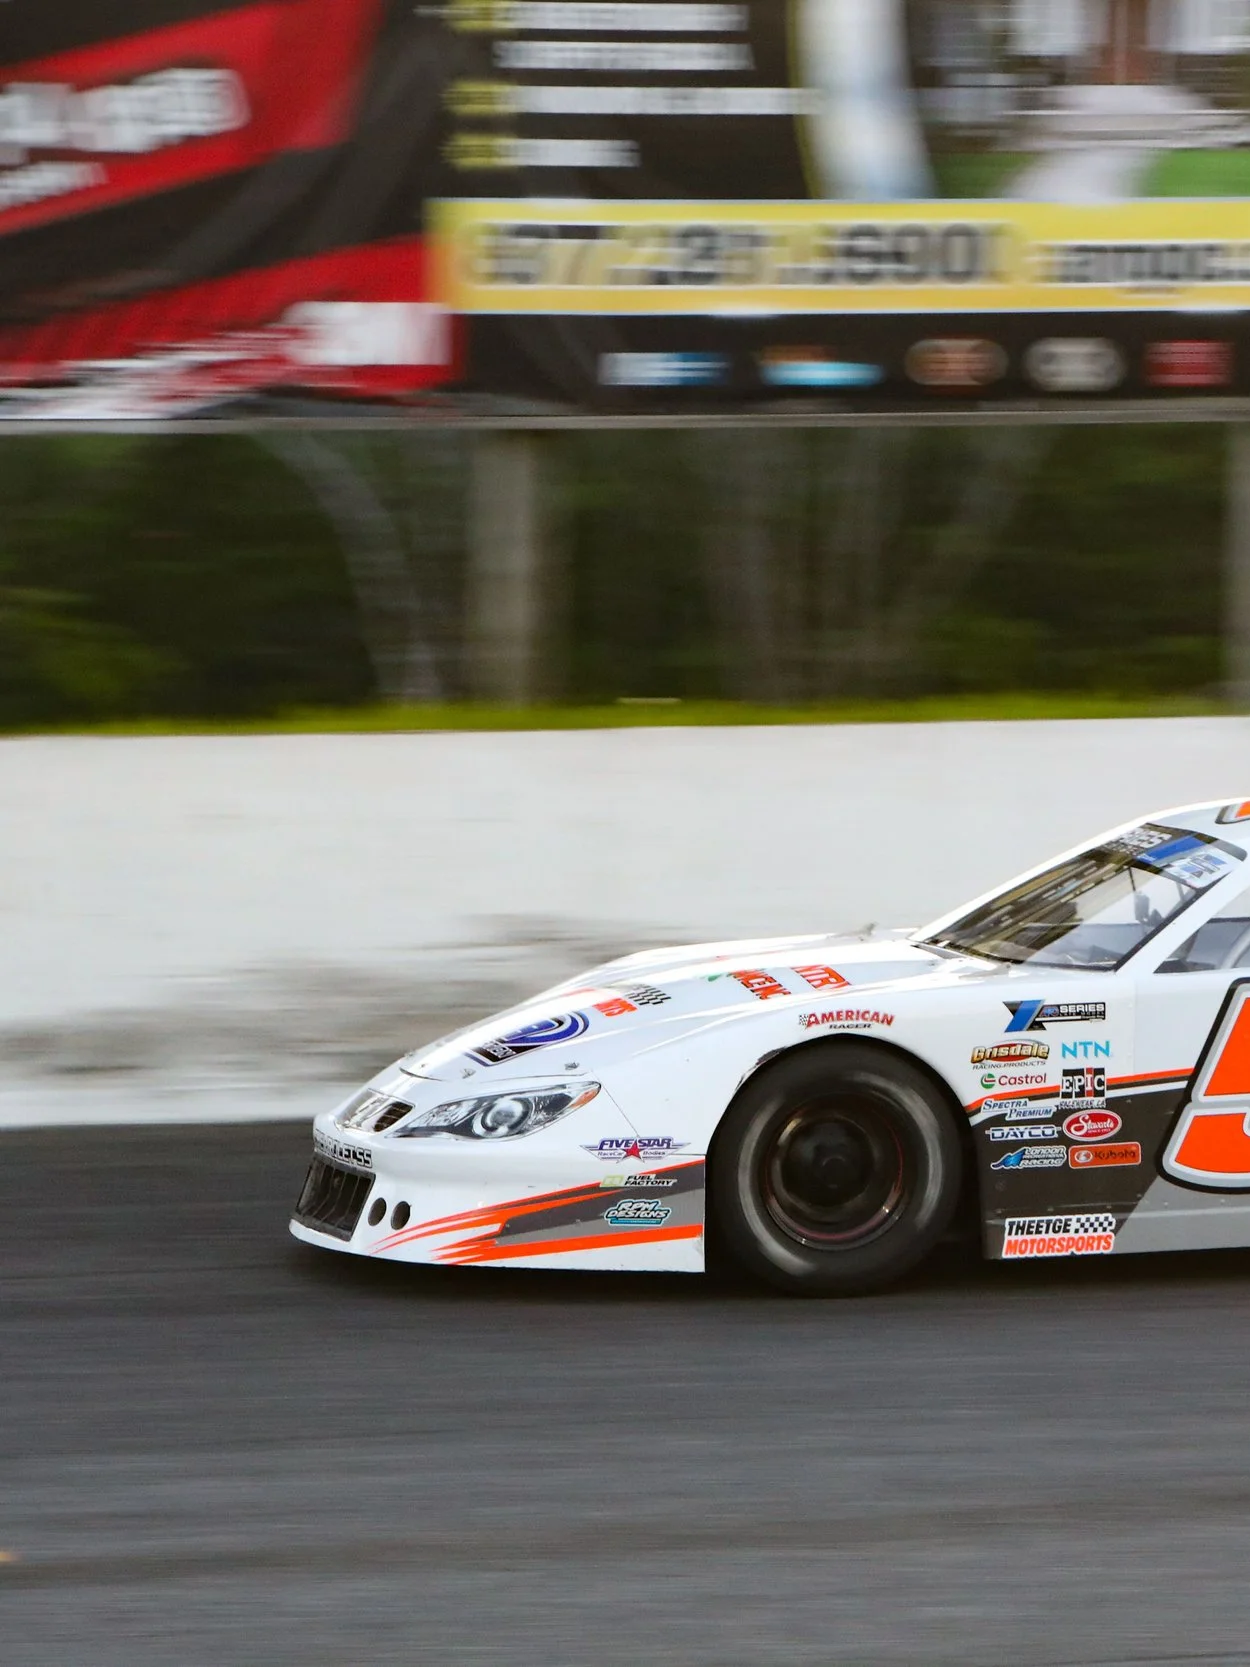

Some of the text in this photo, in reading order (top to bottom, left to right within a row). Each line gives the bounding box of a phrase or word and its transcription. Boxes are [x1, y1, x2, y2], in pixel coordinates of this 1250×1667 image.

[1060, 1003, 1105, 1013] SERIES
[806, 1009, 895, 1028] AMERICAN
[971, 1043, 1050, 1063] Grisdale
[1061, 1040, 1110, 1059] NTN
[1003, 1060, 1046, 1068] PRODUCTS
[998, 1073, 1047, 1086] Castrol
[1061, 1073, 1105, 1094] EPIC
[1008, 1108, 1052, 1118] PREMIUM
[991, 1127, 1055, 1140] DAYCO
[599, 1138, 672, 1150] FIVE STAR
[618, 1202, 658, 1210] RPM
[607, 1210, 668, 1218] DESIGNS
[1007, 1218, 1072, 1235] THEETGE
[1005, 1234, 1113, 1255] MOTORSPORTS
